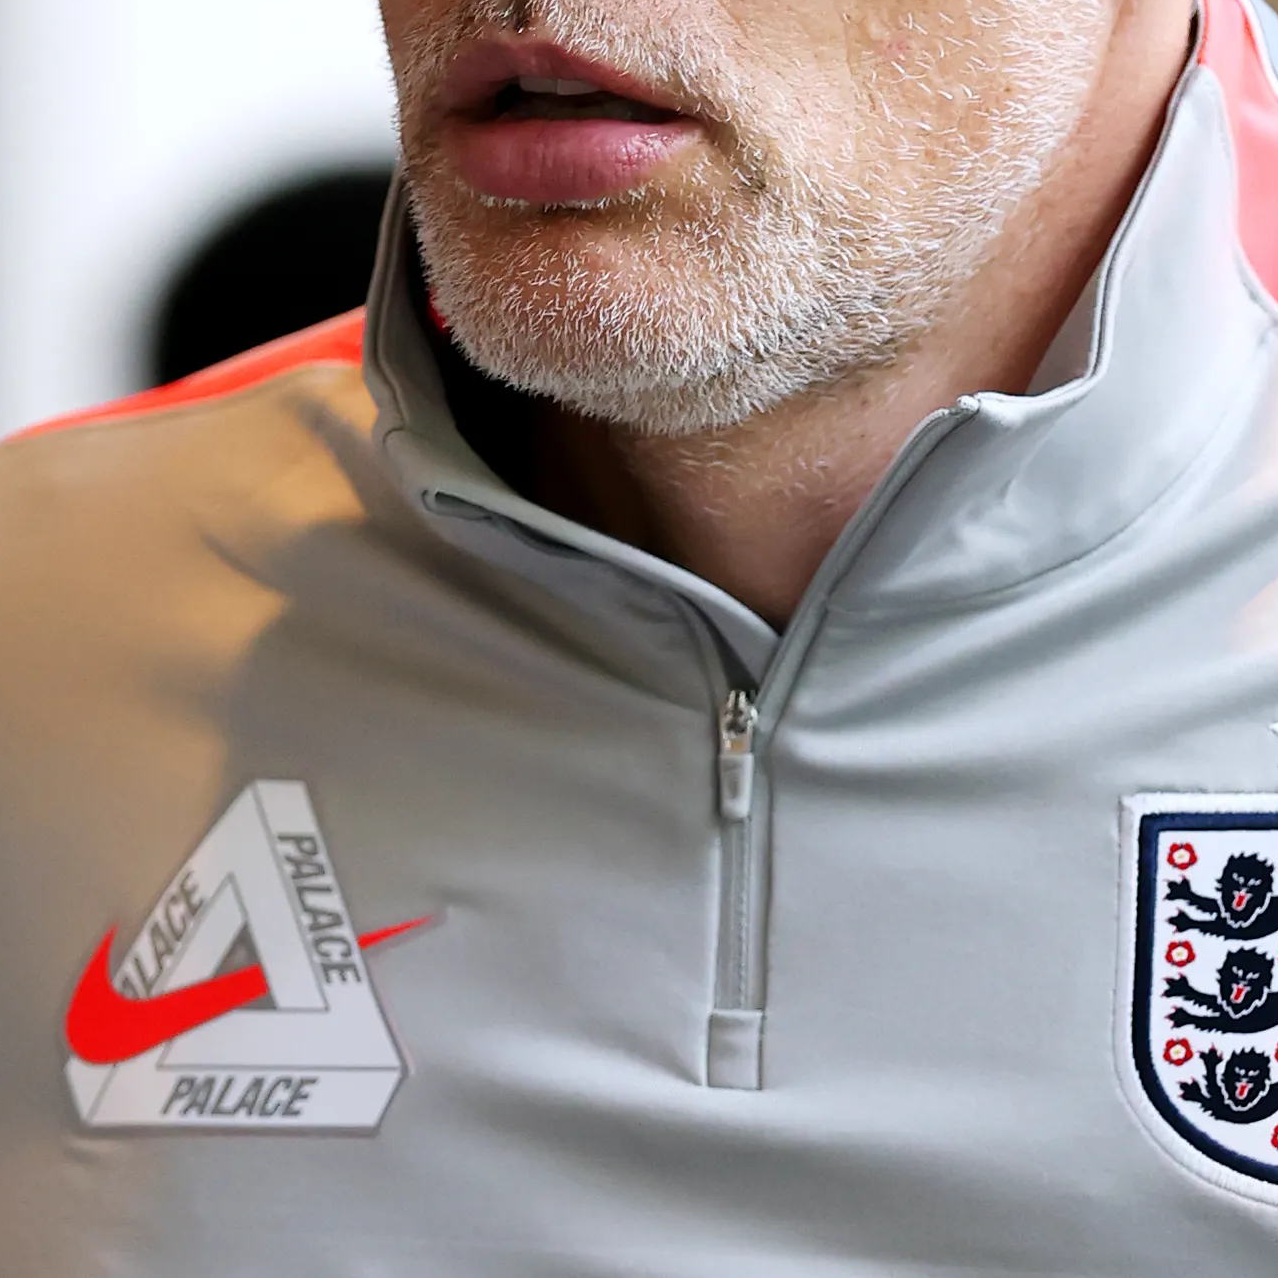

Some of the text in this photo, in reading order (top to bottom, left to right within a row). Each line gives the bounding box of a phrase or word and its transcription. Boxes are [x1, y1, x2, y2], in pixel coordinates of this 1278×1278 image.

[122, 871, 206, 1001] LACE
[276, 832, 364, 986] PALACE
[160, 1076, 317, 1118] PALACE
